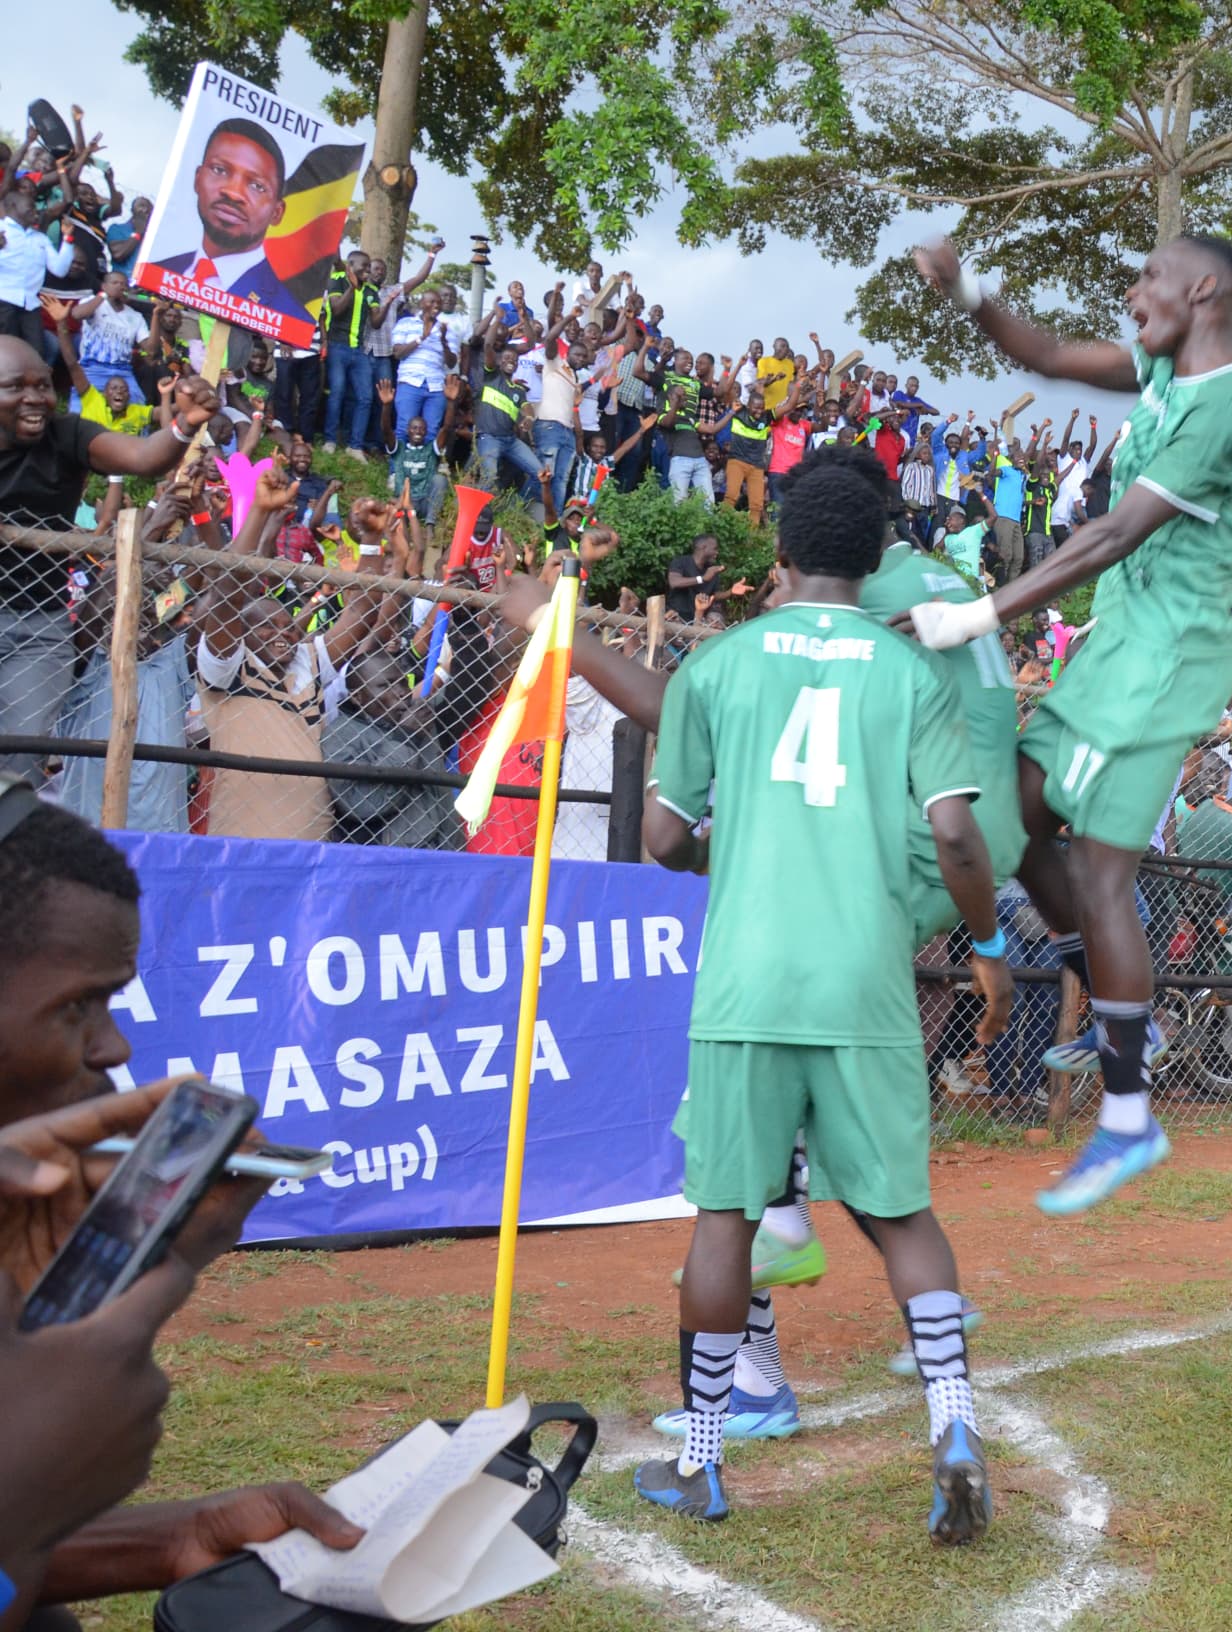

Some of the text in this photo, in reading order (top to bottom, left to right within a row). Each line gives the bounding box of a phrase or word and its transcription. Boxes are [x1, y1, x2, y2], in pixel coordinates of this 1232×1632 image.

[202, 68, 323, 143] PRESIDENT
[159, 285, 281, 337] SSENTAMU ROBERT
[162, 271, 283, 326] KYAGULANYI
[771, 686, 847, 807] 4
[197, 913, 707, 1018] Z'OMUPIIR
[319, 1123, 438, 1191] Cup)
